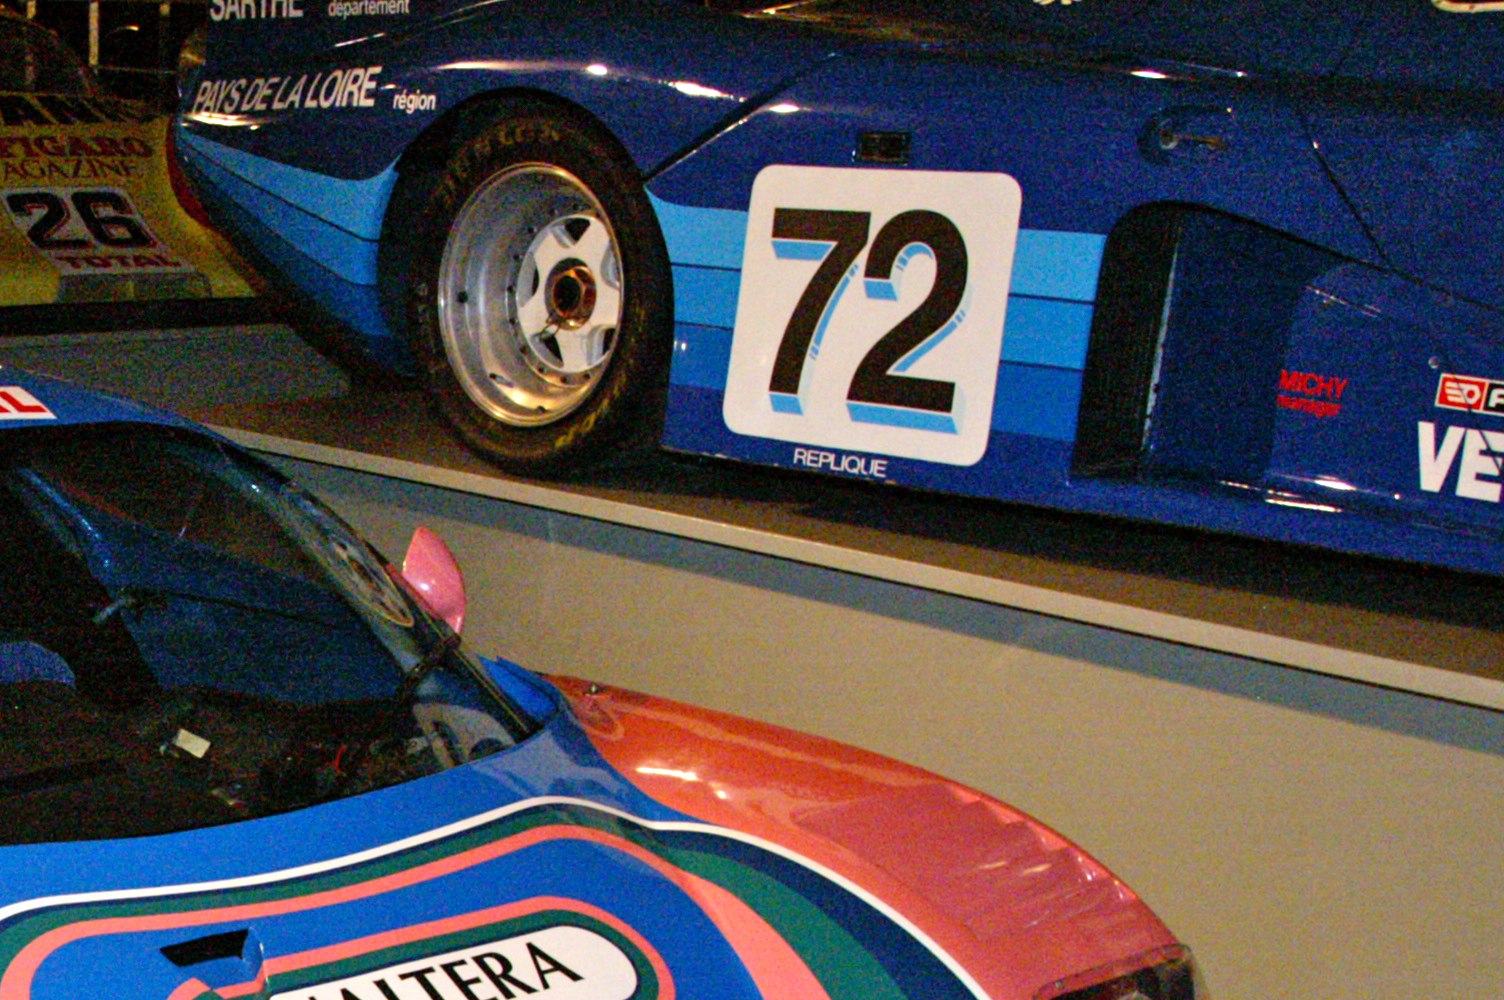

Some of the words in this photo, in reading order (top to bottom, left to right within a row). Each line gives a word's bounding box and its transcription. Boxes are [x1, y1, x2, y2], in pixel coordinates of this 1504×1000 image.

[192, 79, 242, 114] PAYS
[241, 77, 280, 111] DE
[272, 74, 307, 110] LA
[304, 66, 383, 109] LOIRE
[392, 90, 437, 115] région
[4, 190, 160, 251] 26
[54, 255, 184, 270] TOTAL
[768, 207, 970, 434] 72
[1278, 369, 1348, 399] MICHY
[1276, 394, 1343, 419] manager
[792, 447, 889, 479] REPLIQUE
